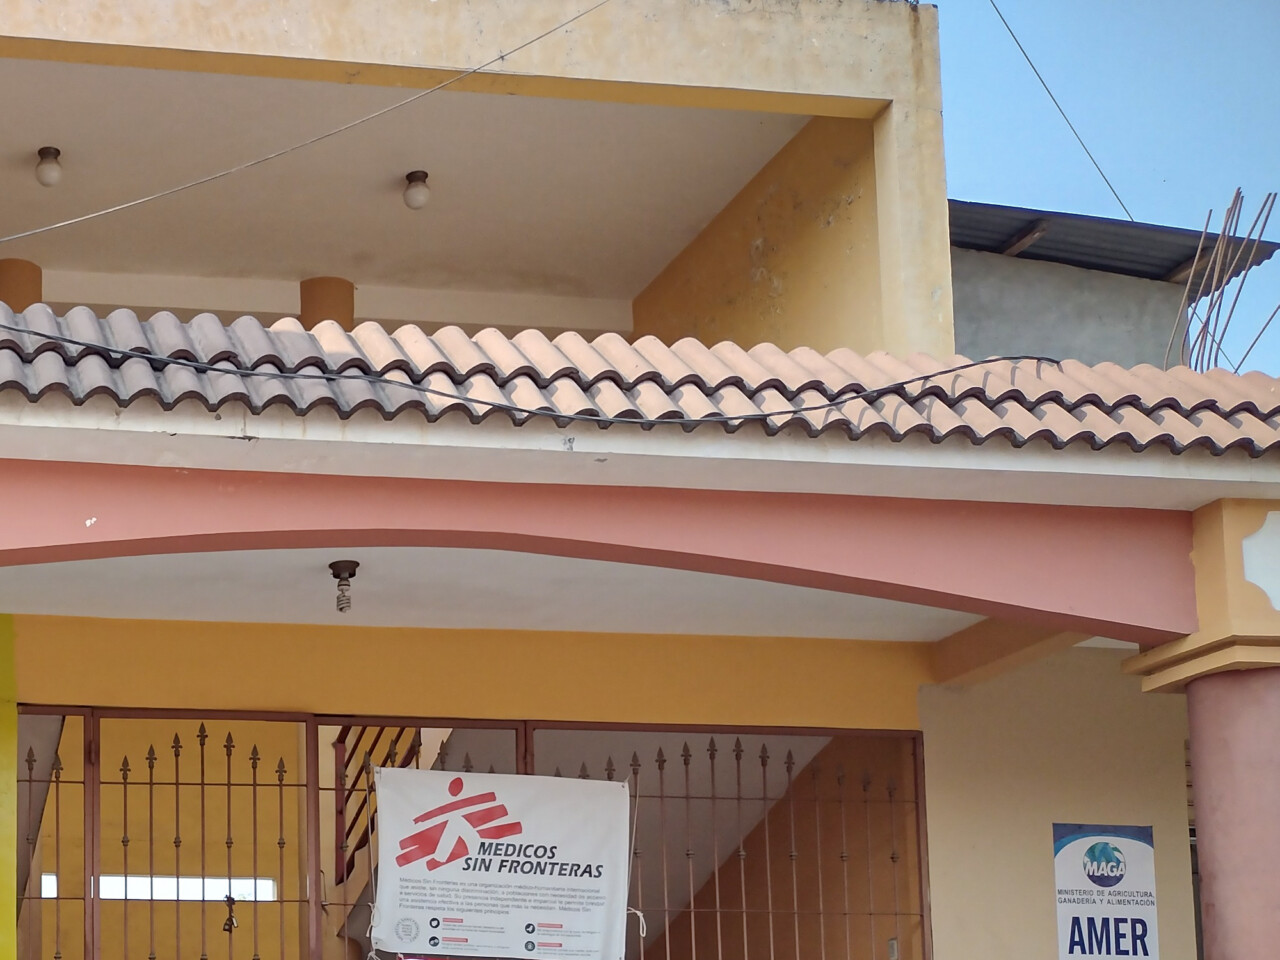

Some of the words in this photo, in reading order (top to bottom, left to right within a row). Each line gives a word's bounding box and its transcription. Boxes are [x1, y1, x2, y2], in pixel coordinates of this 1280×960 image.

[478, 842, 558, 860] MEDICOS
[462, 857, 493, 872] SIN
[498, 859, 604, 878] FRONTERAS
[1084, 861, 1126, 876] MAGA
[1107, 898, 1155, 906] ALIMENTACIÓN
[1108, 890, 1154, 898] AGRICULTURA,
[1068, 916, 1149, 956] AMER
